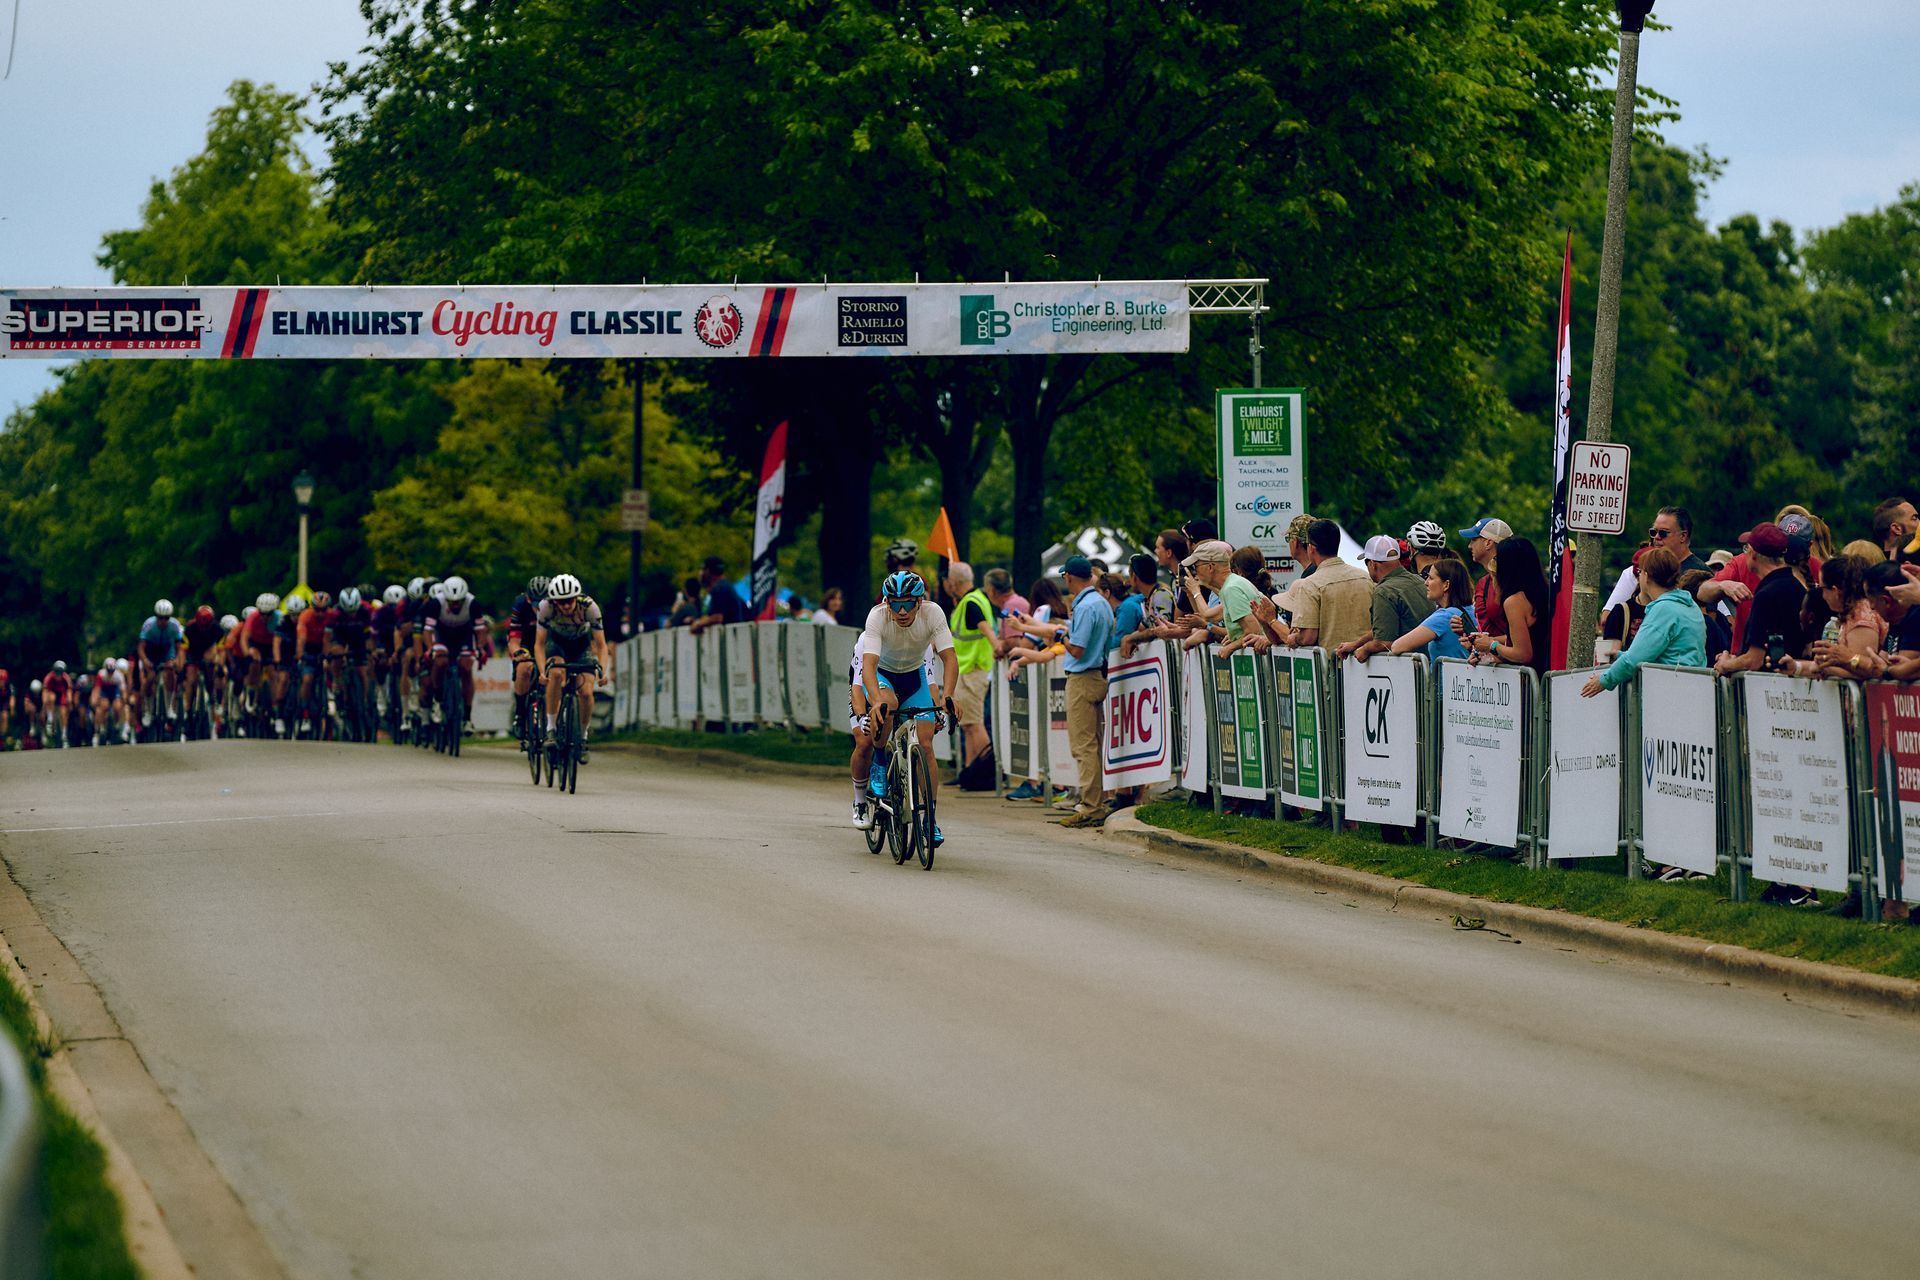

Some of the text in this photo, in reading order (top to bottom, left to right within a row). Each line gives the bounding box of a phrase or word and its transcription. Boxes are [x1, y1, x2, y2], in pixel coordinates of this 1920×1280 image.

[841, 299, 900, 313] STORINO
[1013, 300, 1168, 319] Christopher B. Burke
[3, 309, 212, 333] SUPERIOR
[272, 299, 683, 347] ELMHURST Cycling CLASSIC
[841, 315, 905, 329] RAMELLO
[1141, 316, 1167, 332] Ltd.
[13, 340, 199, 350] AMBULANCE SERVICE
[841, 331, 905, 344] &DURKIN
[1239, 405, 1284, 418] ELMHURST
[1240, 417, 1285, 431] TWILIGHT
[1250, 430, 1275, 445] MILE
[1590, 451, 1611, 469] NO
[1574, 472, 1623, 492] PARKING
[1235, 502, 1292, 511] C&C POWER
[1575, 493, 1620, 508] THIS SIDE
[1572, 510, 1620, 525] OF STREET
[1251, 524, 1277, 538] CK
[1450, 675, 1511, 710] Alex Tauchen, MD
[1892, 693, 1916, 719] YOUR
[1365, 687, 1391, 744] CK
[1595, 753, 1617, 770] COMPASS
[1656, 738, 1714, 784] MIDWEST
[1657, 780, 1714, 804] CARDIOVASCULAR INSTITUTE
